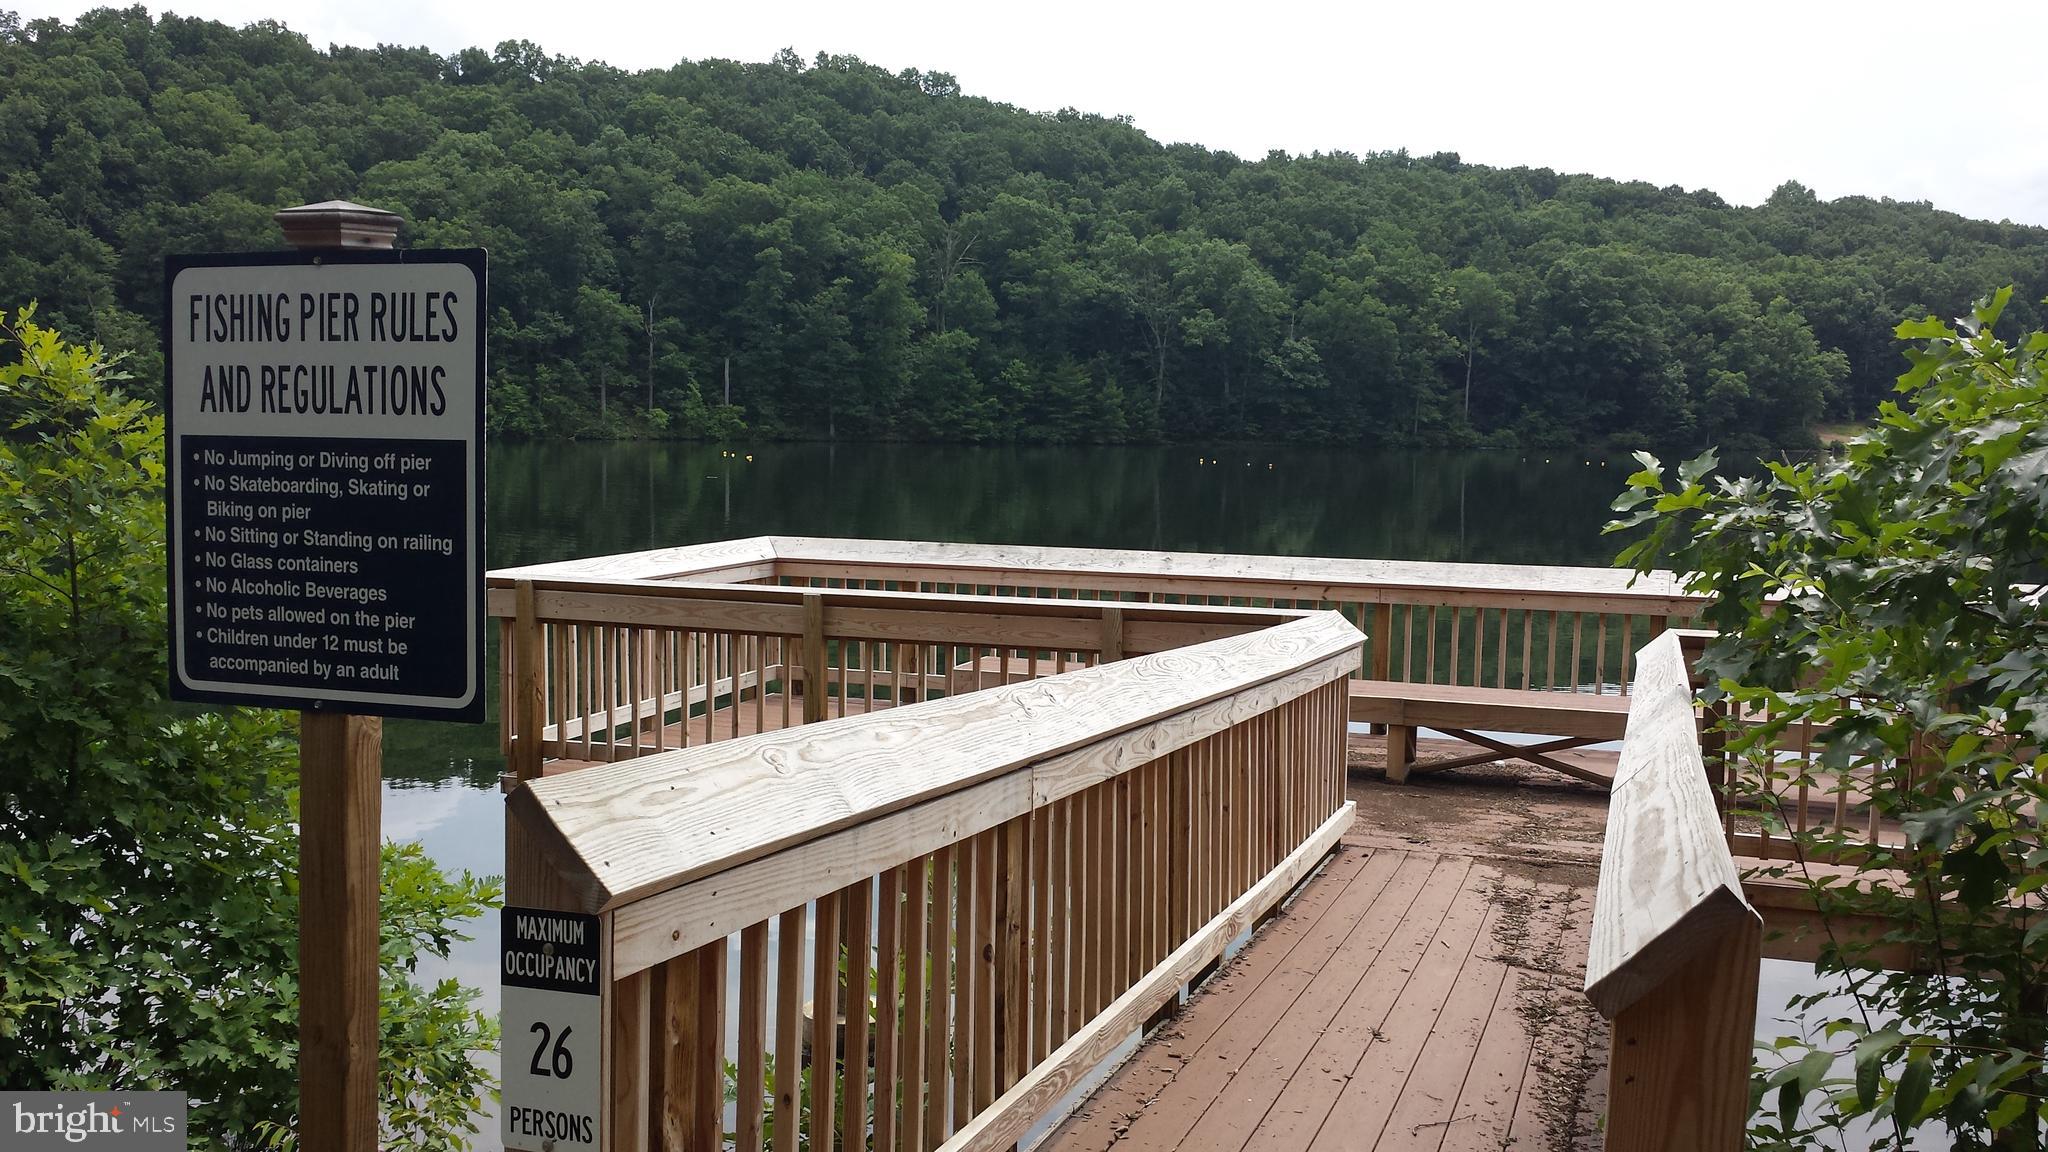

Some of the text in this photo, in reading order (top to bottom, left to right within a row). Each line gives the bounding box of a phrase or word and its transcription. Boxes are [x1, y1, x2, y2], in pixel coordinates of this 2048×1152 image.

[190, 291, 458, 342] FISHING PIER RULES
[200, 364, 446, 416] AND REGULATIONS
[204, 450, 432, 474] No Jumping or Diving off pier
[204, 475, 431, 500] No Skateboarding, Skating or
[207, 500, 311, 522] Biking on pier
[205, 526, 453, 555] No Sitting or Standing on railing
[205, 551, 359, 574] No Glass containers
[206, 577, 387, 605] No Alcoholic Beverages
[206, 602, 416, 632] No pets allowed on the pier
[207, 627, 408, 655] Children under 12 must be
[209, 654, 400, 681] accompanied by an adult
[516, 915, 584, 945] MAXIMUM
[505, 950, 597, 984] OCCUPANCY
[530, 1021, 573, 1080] 26
[510, 1106, 593, 1144] PERSONS
